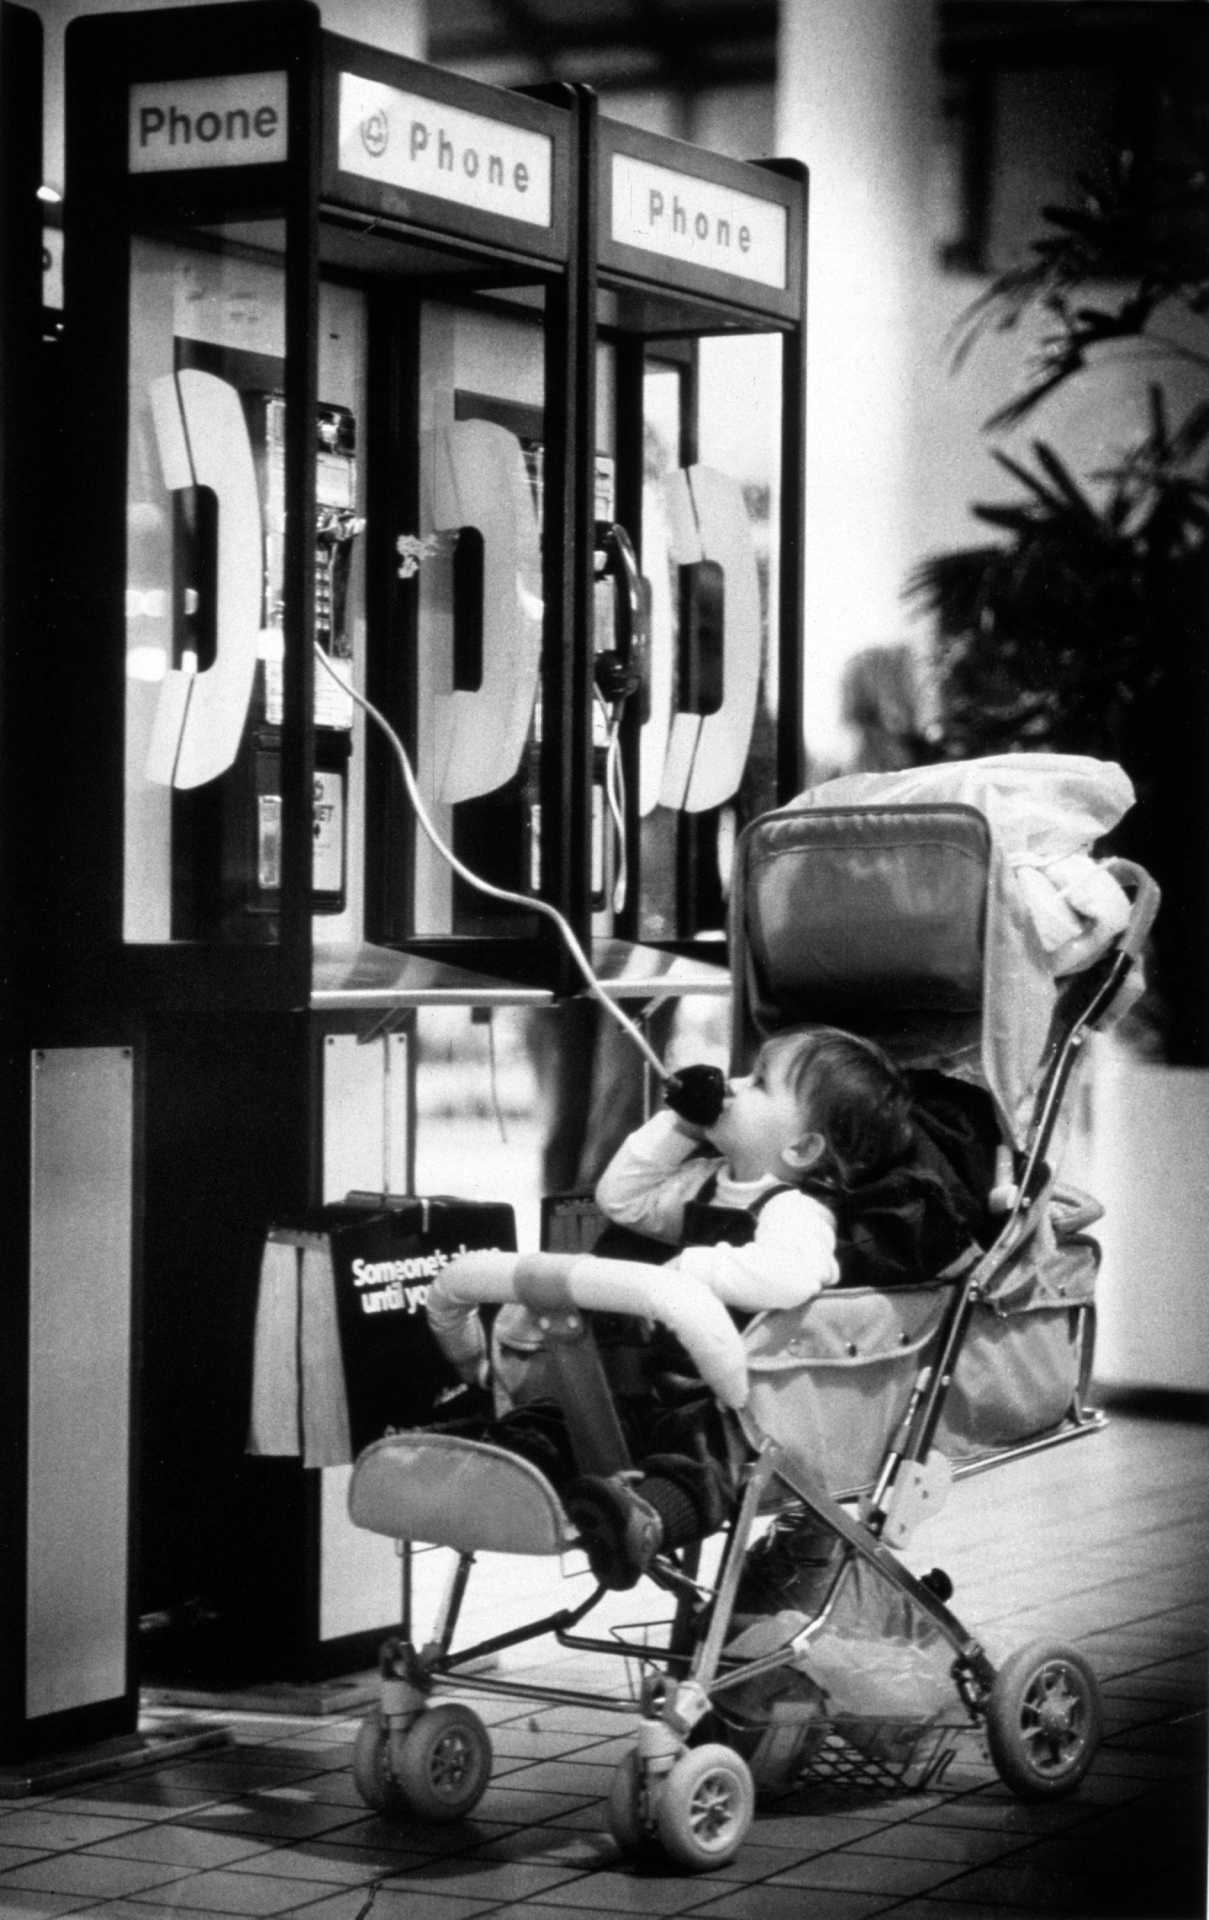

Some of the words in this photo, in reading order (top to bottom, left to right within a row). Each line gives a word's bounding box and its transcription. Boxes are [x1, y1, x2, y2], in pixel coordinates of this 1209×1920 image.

[139, 105, 279, 147] Phone
[409, 120, 530, 193] Phone
[649, 188, 751, 253] Phone
[361, 1281, 405, 1314] until
[404, 1284, 432, 1315] yo
